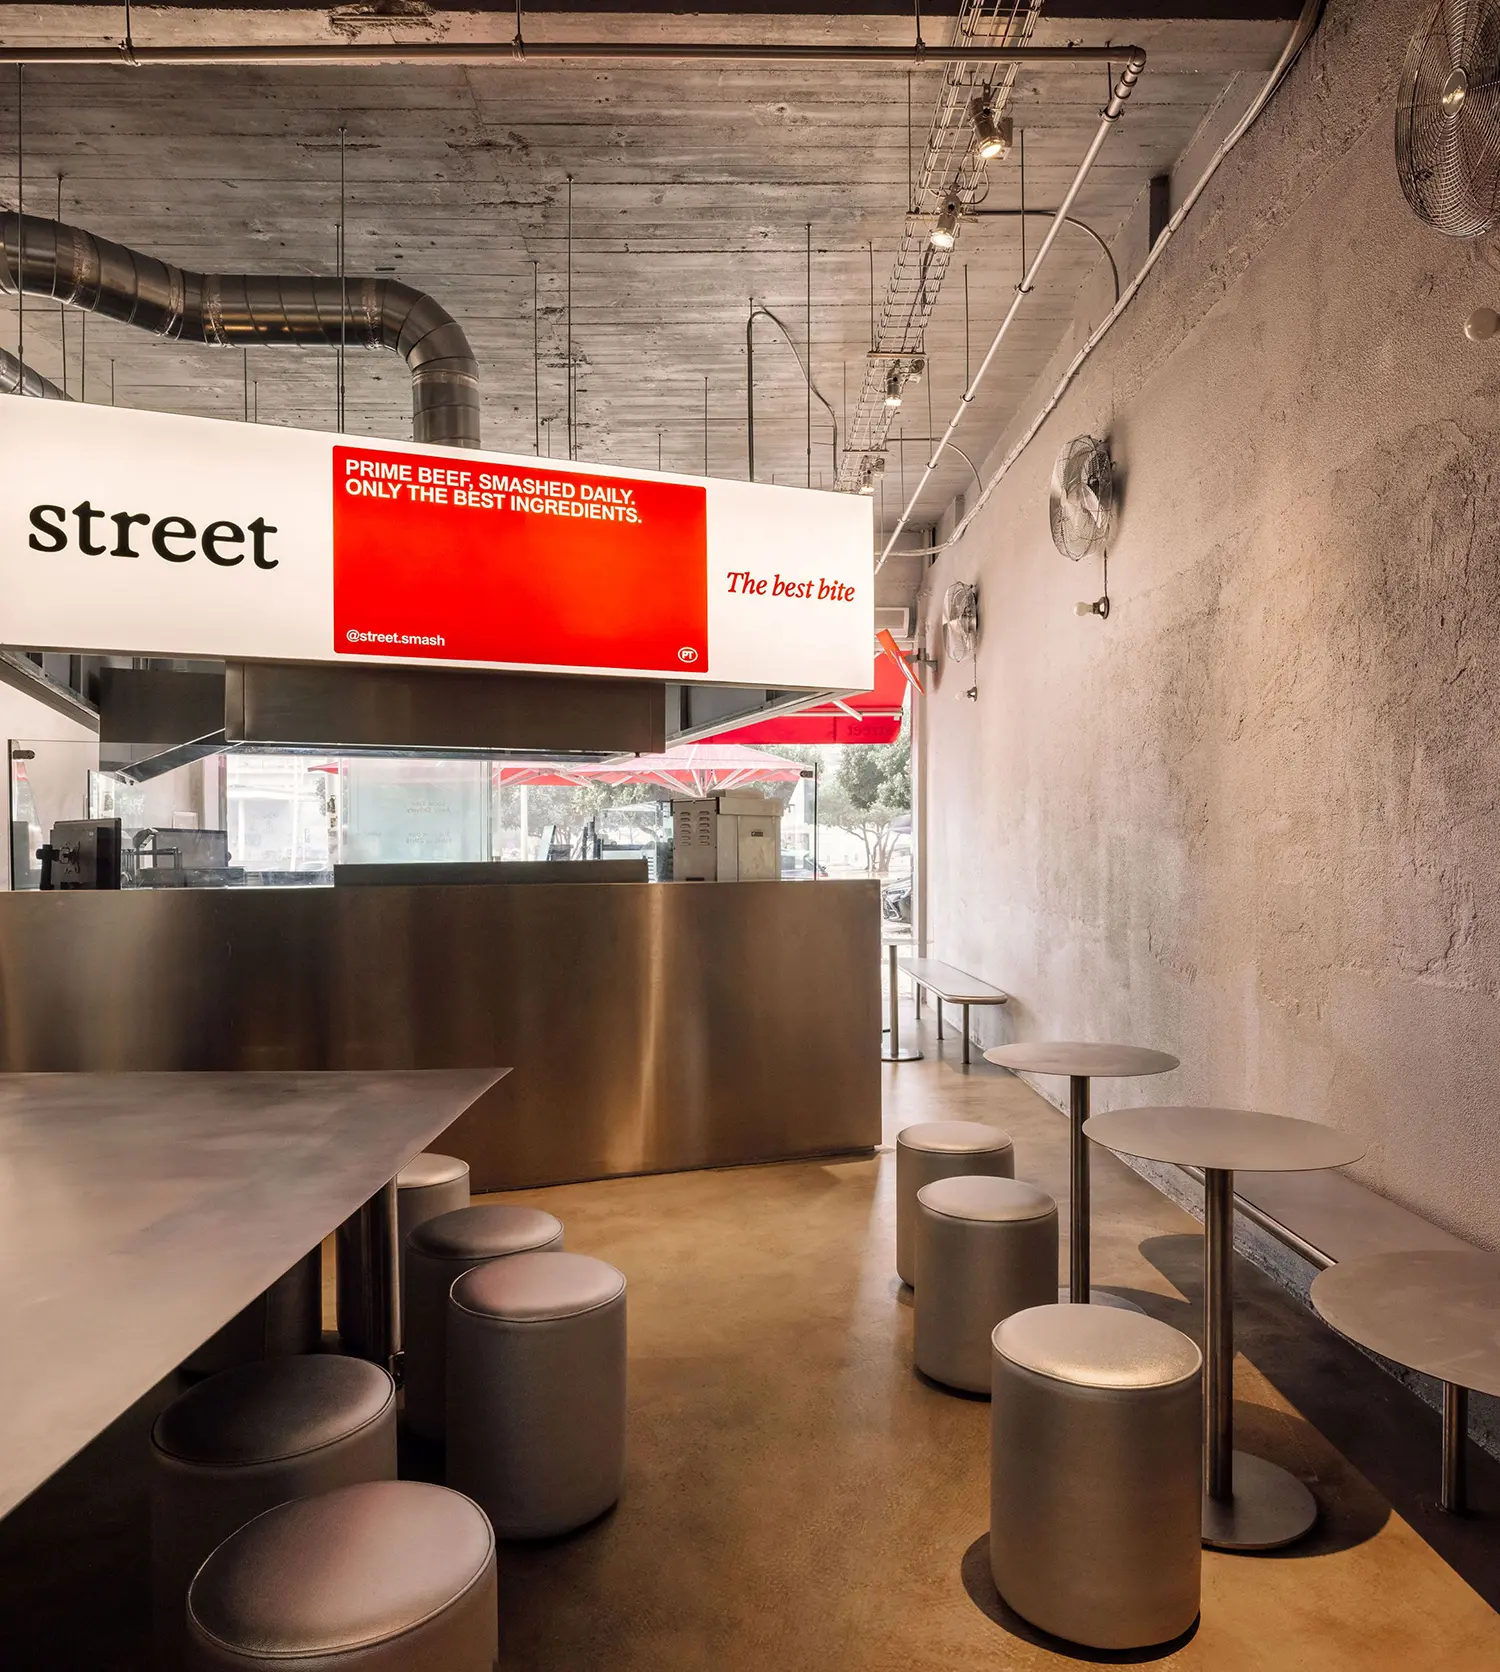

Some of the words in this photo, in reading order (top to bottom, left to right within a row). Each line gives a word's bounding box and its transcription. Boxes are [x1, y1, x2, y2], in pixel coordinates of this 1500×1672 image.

[345, 478, 403, 499] ONLY
[406, 484, 448, 504] THE
[453, 489, 506, 510] BEST
[510, 495, 643, 524] INGREDIENTS.
[346, 459, 413, 481] PRIME
[418, 466, 474, 490] BEEF,
[479, 473, 576, 499] SMASHED
[580, 484, 636, 506] DAILY.
[29, 500, 279, 570] street
[727, 571, 768, 596] The
[772, 573, 815, 599] best
[817, 577, 856, 602] bite
[346, 629, 446, 647] @street.smash
[682, 650, 694, 660] PT
